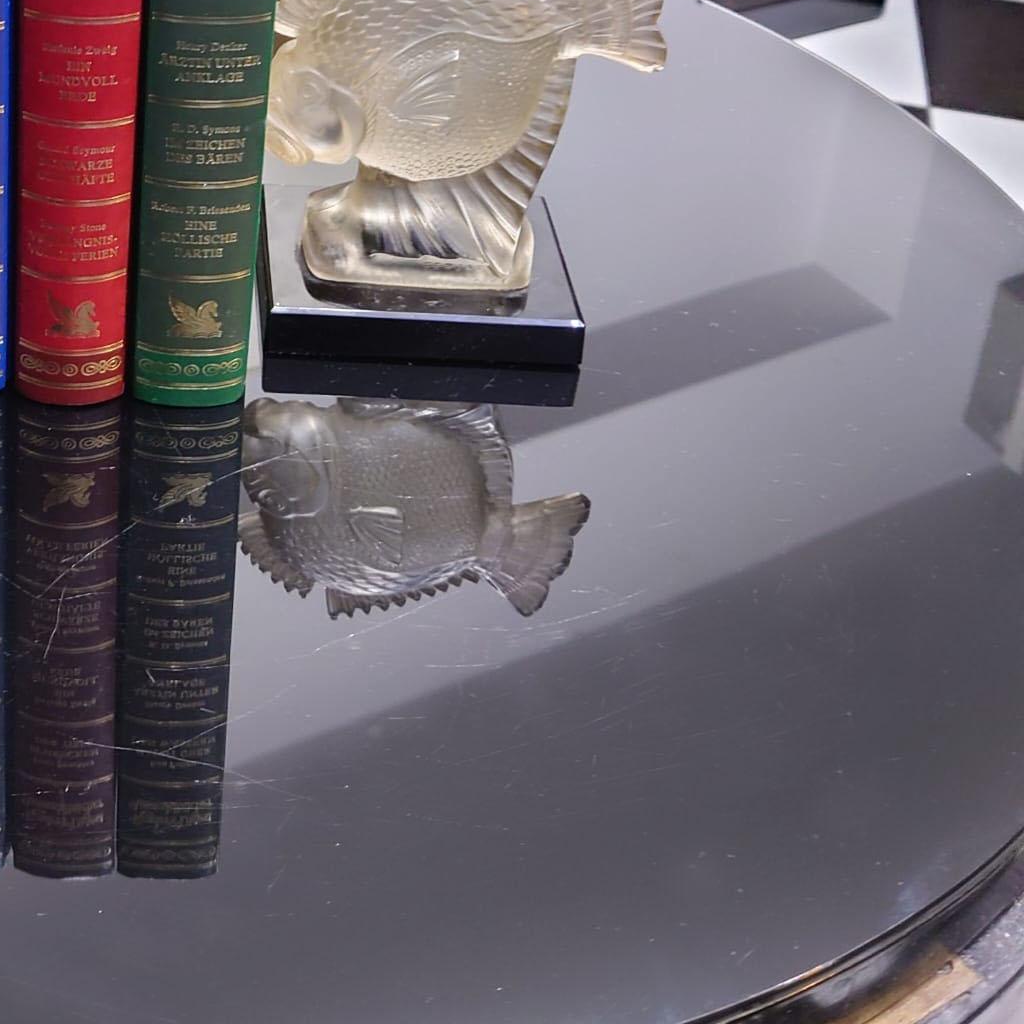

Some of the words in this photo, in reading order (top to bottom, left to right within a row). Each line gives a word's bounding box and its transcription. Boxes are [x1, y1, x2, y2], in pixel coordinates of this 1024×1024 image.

[84, 43, 119, 56] Zweig
[66, 60, 93, 73] EIN
[214, 55, 263, 69] UNTER
[185, 138, 247, 151] ZEICHEN
[38, 156, 113, 172] SWARZE
[195, 152, 246, 165] BÄREN
[183, 220, 218, 231] EINE
[174, 247, 225, 259] PARTIE
